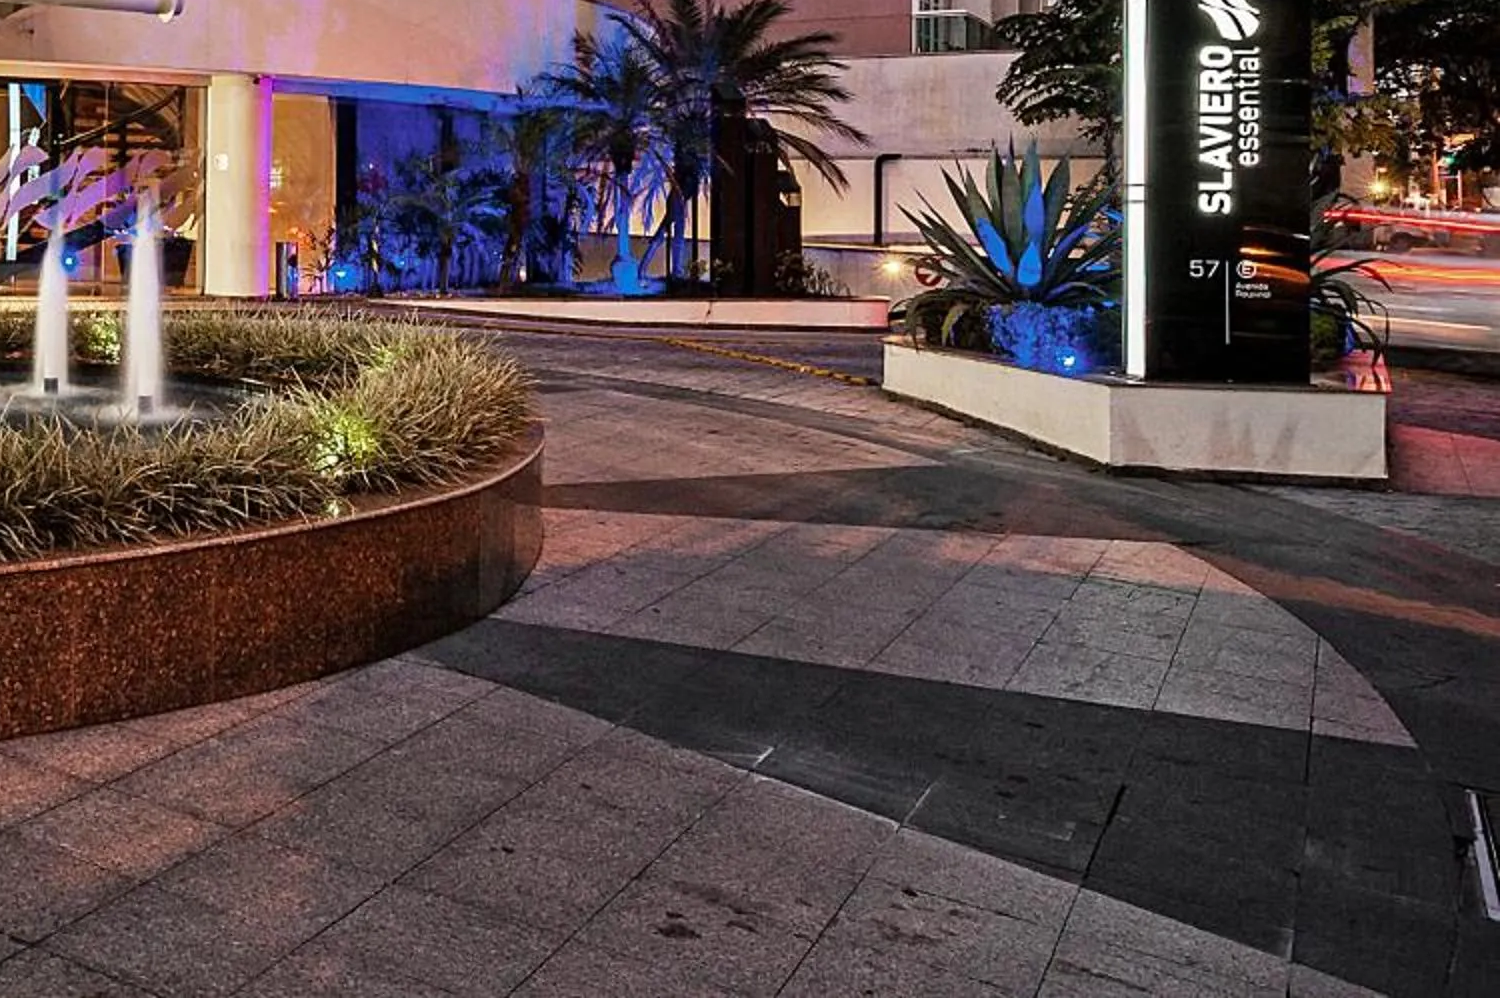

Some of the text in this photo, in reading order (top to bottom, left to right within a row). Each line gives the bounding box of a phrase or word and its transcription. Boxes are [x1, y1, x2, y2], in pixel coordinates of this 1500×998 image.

[1198, 45, 1234, 215] SLAVIERO
[1232, 46, 1260, 167] essential
[1189, 259, 1220, 278] 57
